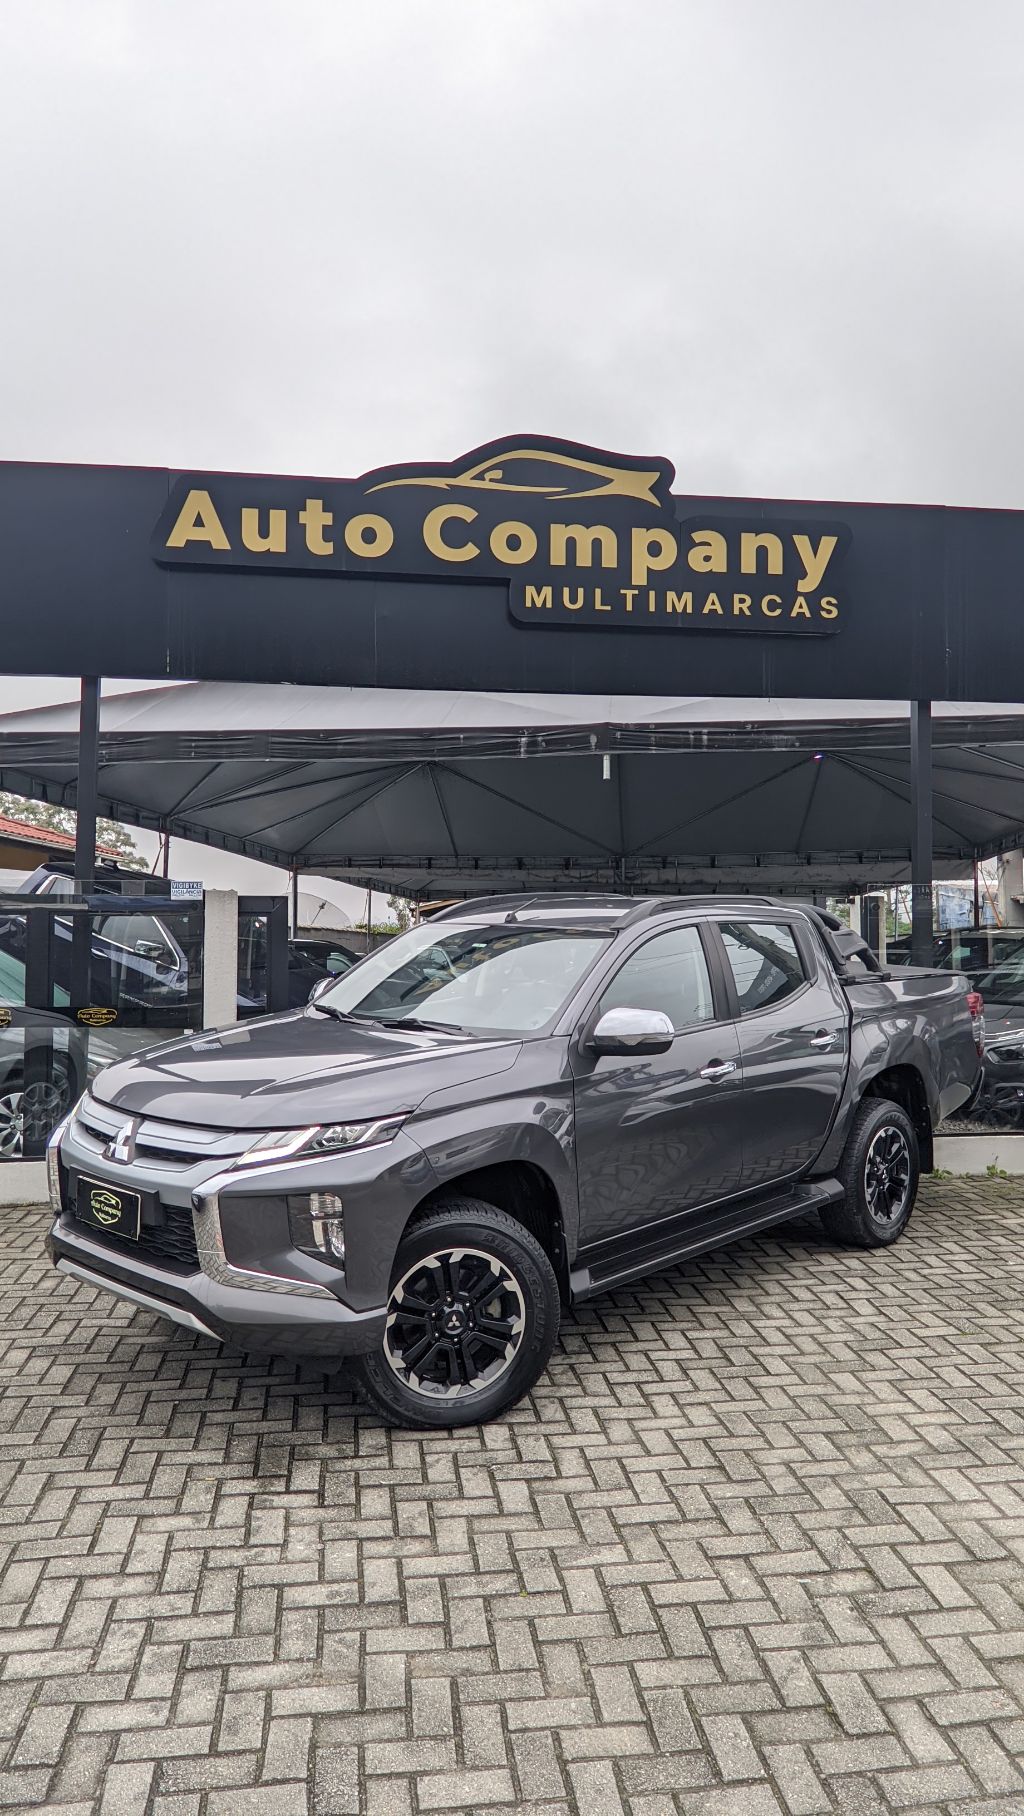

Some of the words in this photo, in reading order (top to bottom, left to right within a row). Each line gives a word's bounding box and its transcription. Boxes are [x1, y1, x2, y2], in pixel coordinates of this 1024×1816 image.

[167, 490, 393, 559] Auto
[422, 504, 837, 593] Company
[524, 584, 840, 621] MULTIMARCAS
